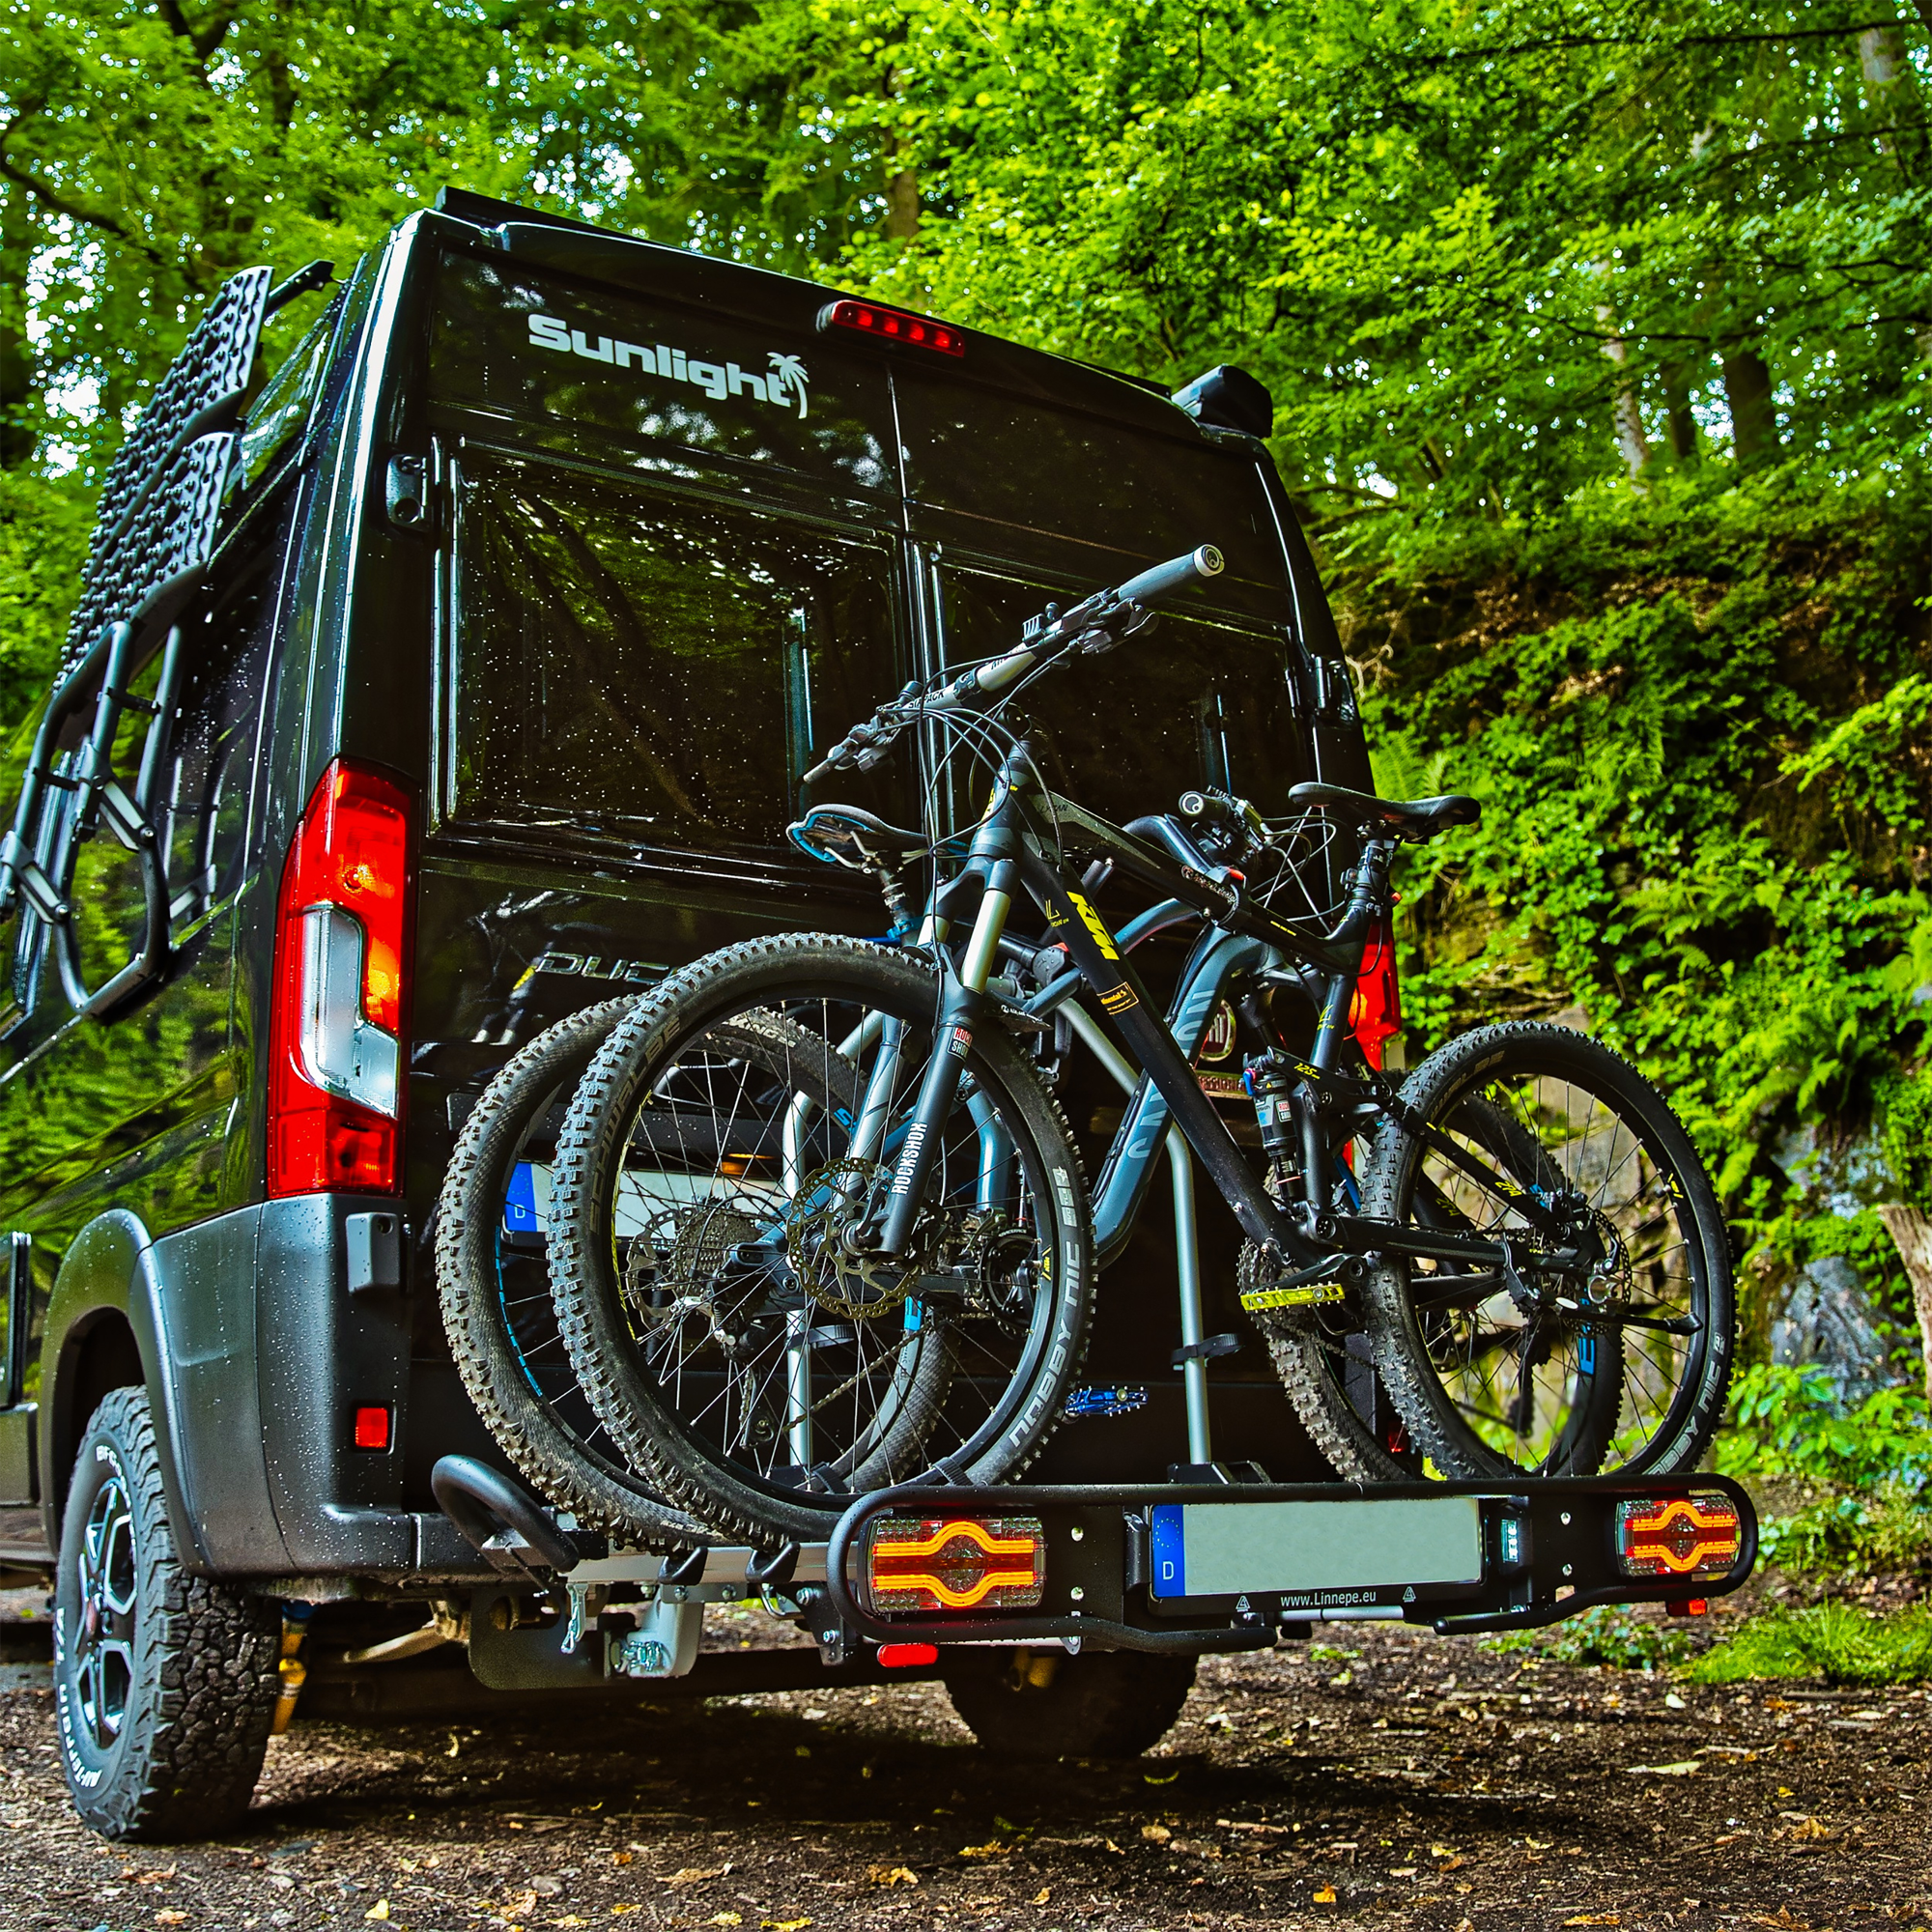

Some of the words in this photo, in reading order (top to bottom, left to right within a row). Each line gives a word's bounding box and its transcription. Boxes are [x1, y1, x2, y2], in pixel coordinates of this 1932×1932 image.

[528, 313, 791, 408] Sunlight
[1065, 891, 1120, 960] KTM
[535, 951, 676, 986] DUC
[1127, 989, 1216, 1159] CAON
[589, 1016, 681, 1235] SCHWALBE
[891, 1122, 927, 1195] ROCKSHOX
[1162, 1561, 1175, 1580] D
[1280, 1590, 1377, 1607] www.Linnepe.eu
